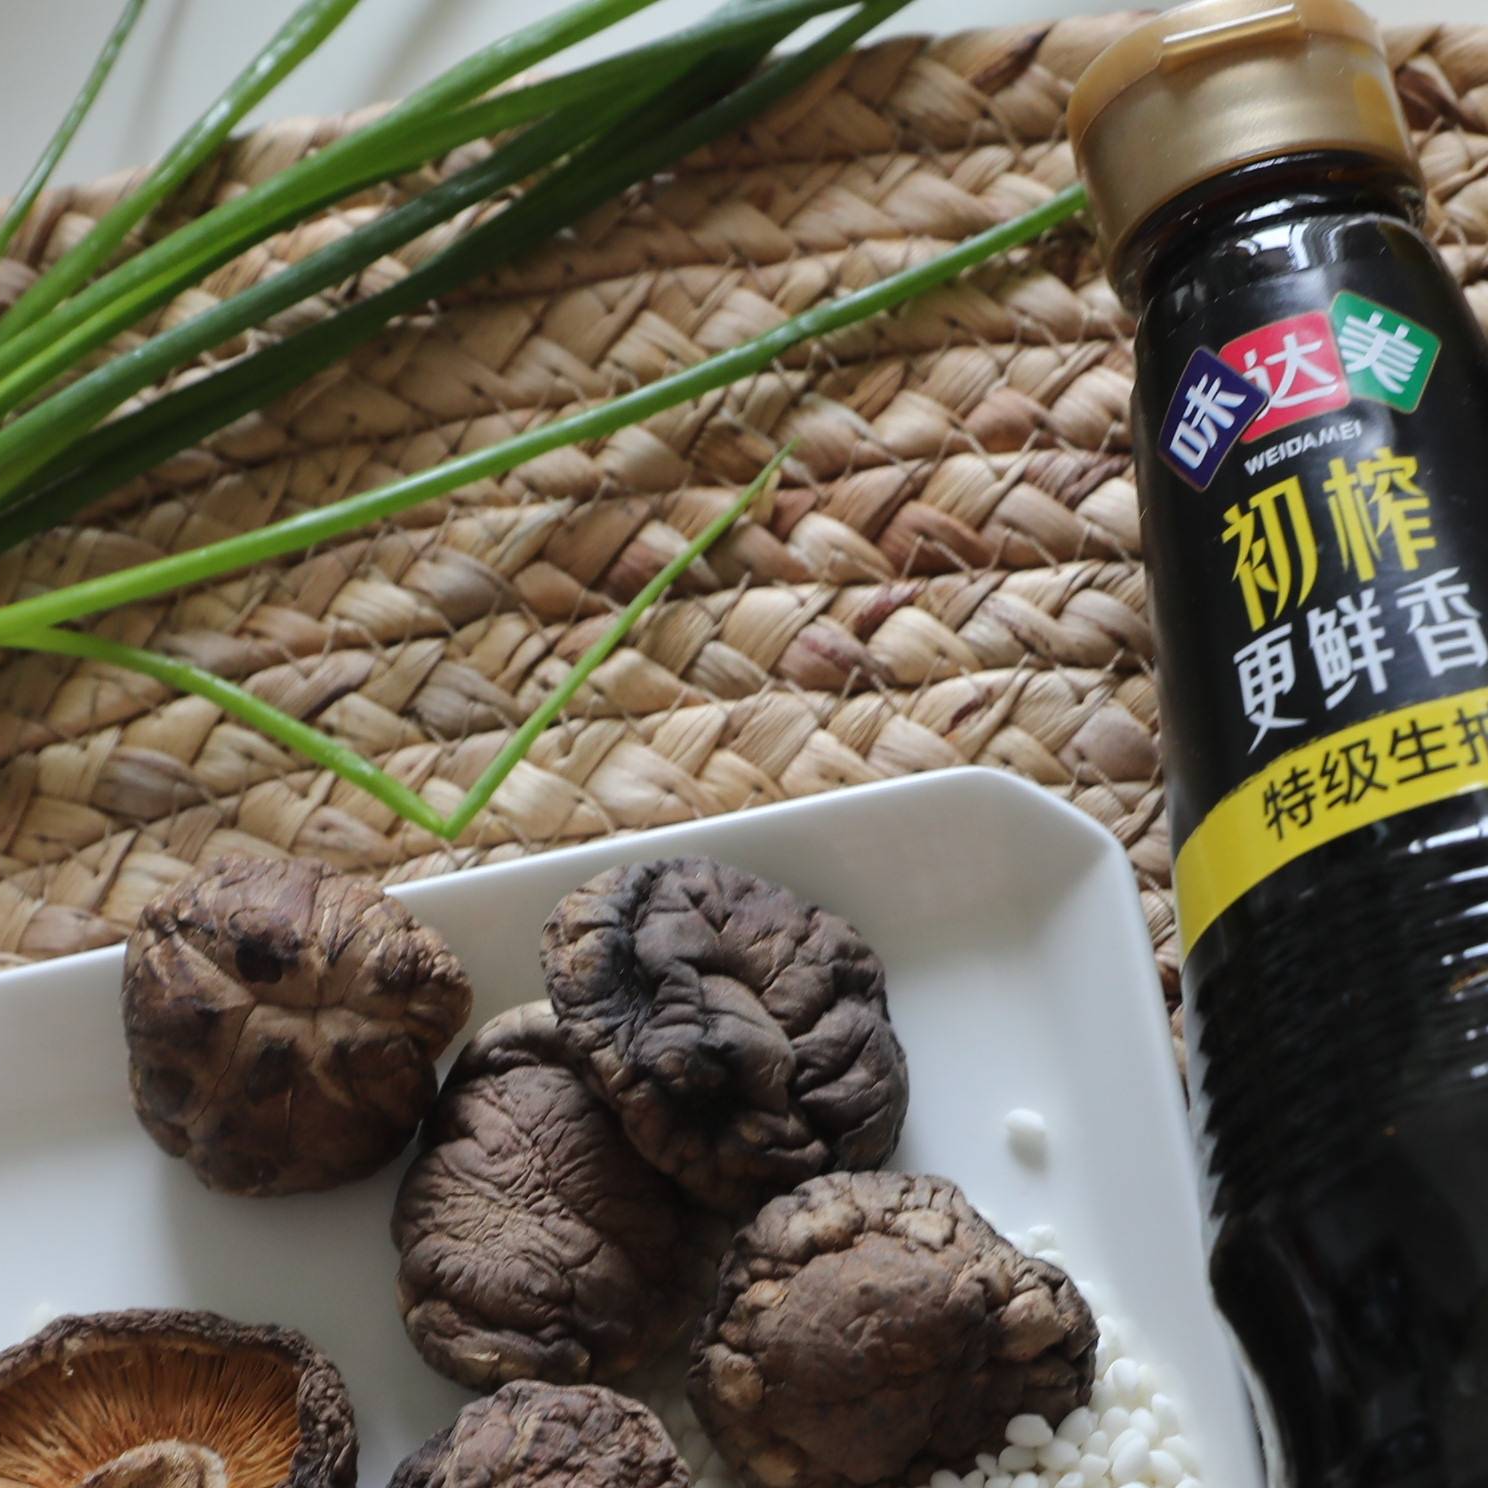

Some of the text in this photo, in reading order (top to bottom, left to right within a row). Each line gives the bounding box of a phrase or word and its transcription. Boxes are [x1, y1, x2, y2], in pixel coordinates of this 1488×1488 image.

[1167, 310, 1424, 470] 味达美
[1244, 420, 1364, 477] WEIDAMEI
[1220, 446, 1437, 633] 初榨
